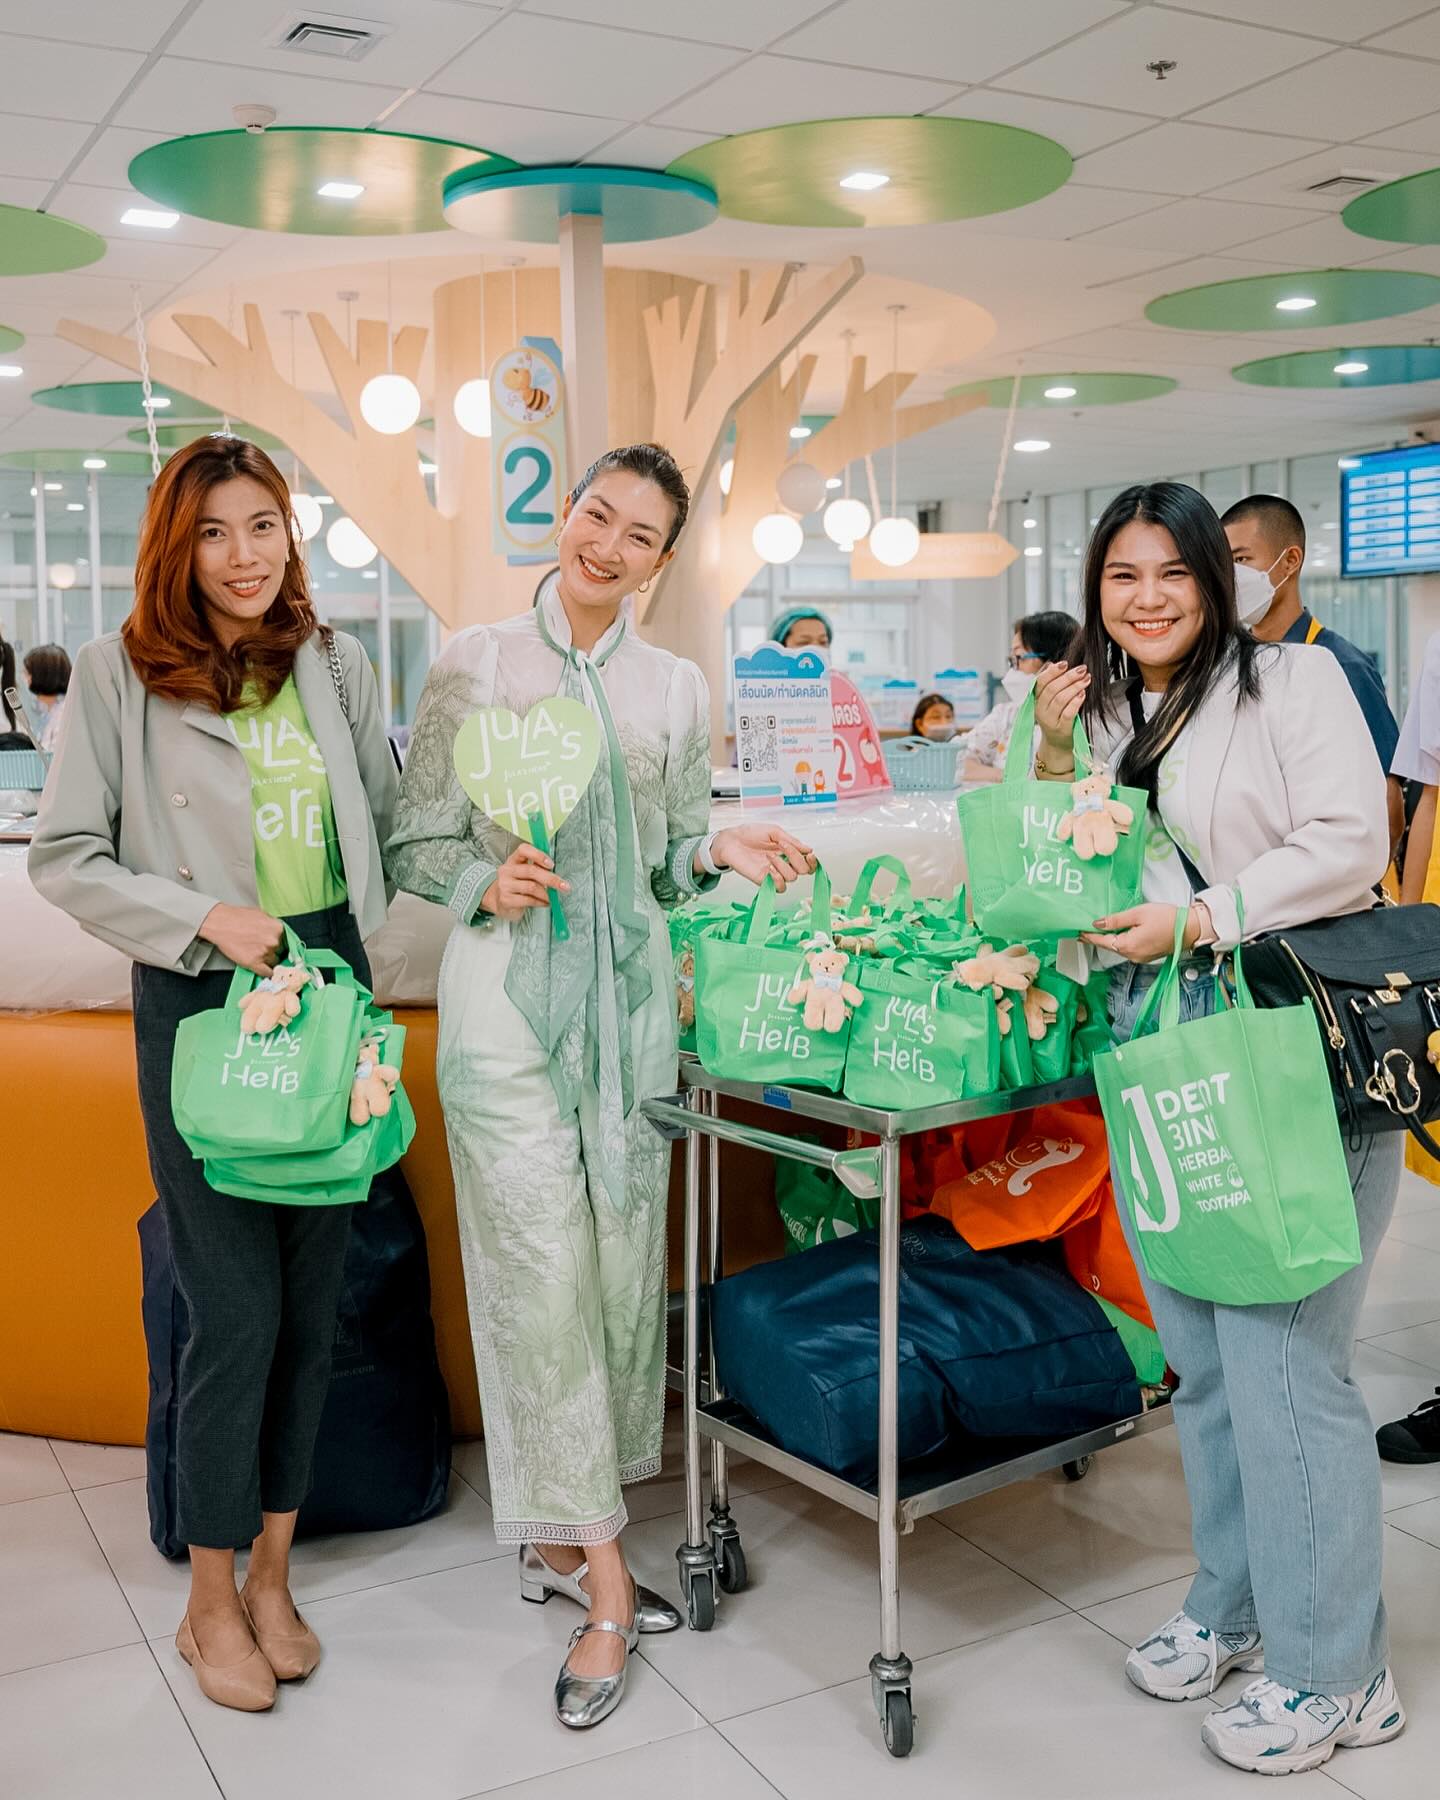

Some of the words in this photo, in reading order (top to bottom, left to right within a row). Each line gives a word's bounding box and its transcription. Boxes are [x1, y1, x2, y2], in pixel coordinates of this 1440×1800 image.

[504, 447, 553, 524] 2
[833, 738, 853, 781] 2
[1167, 1111, 1220, 1151] 3IN
[1177, 1144, 1234, 1174] HERBA
[1185, 1174, 1223, 1193] WHITE
